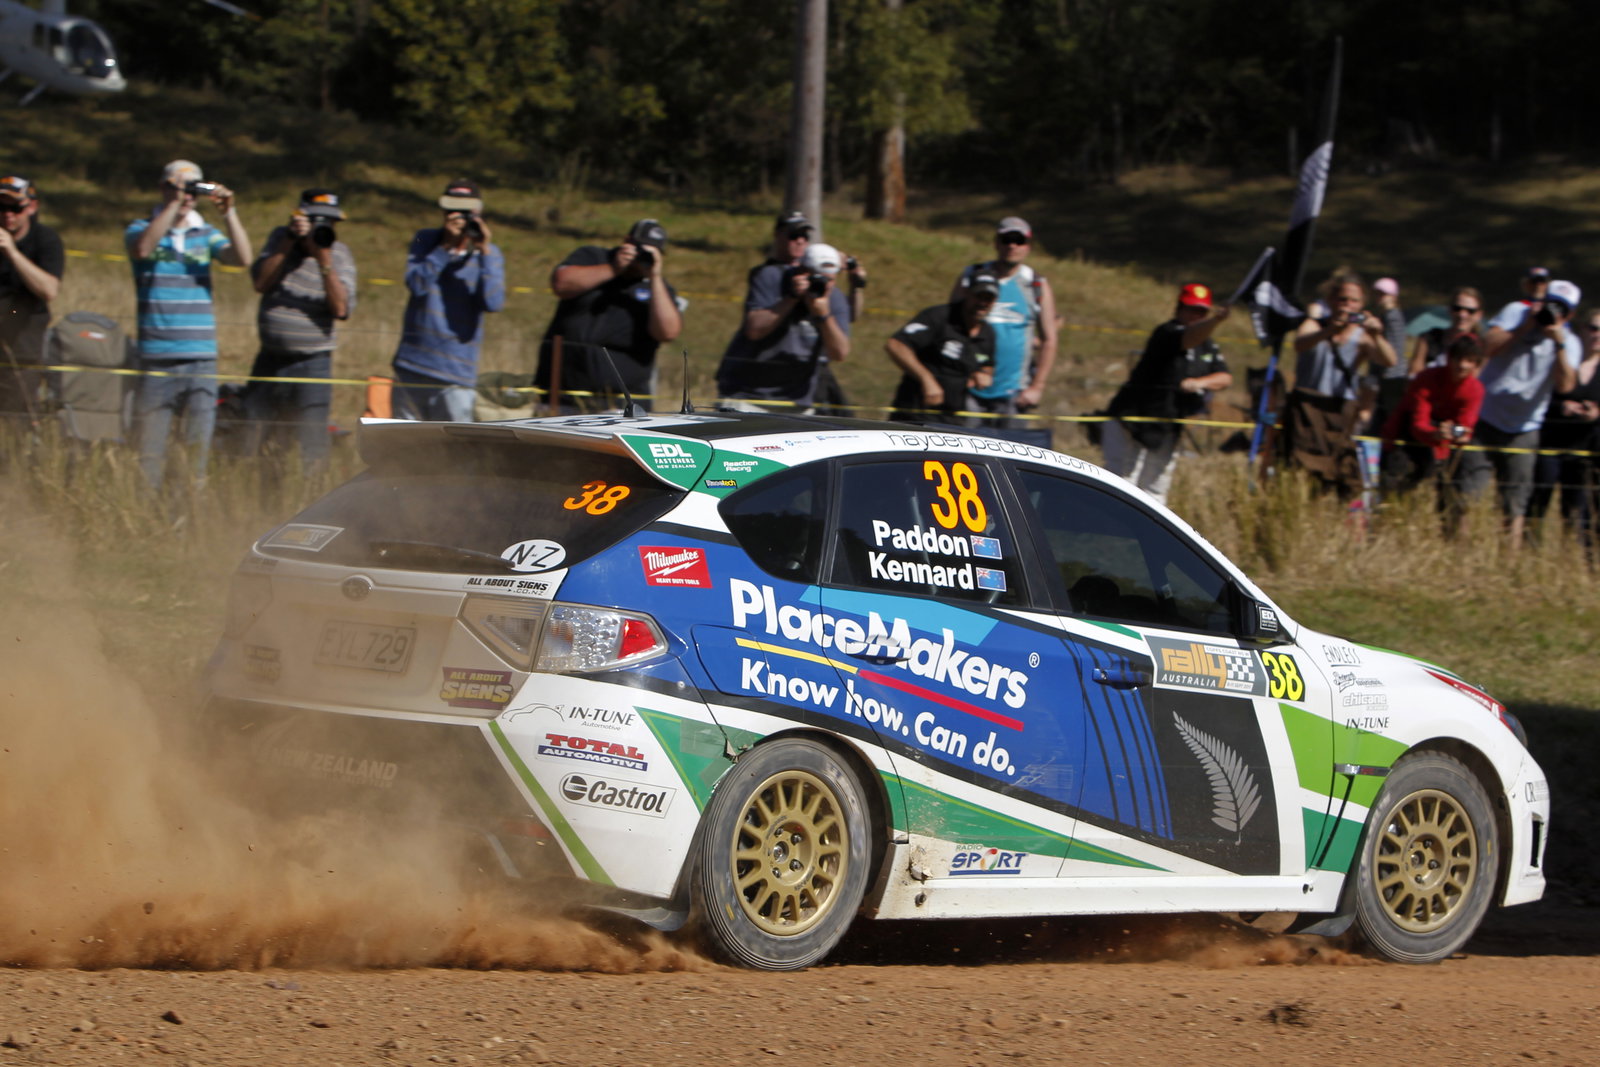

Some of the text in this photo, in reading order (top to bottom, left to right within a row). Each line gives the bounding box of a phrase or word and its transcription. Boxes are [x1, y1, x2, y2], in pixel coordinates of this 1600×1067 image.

[648, 443, 692, 458] EDL
[883, 431, 1100, 475] haydenpaddon.com
[723, 460, 759, 468] Reaction
[563, 480, 631, 516] 38
[923, 460, 988, 533] 38
[872, 519, 970, 557] Paddon
[644, 549, 700, 570] Milwaukee
[868, 551, 975, 590] Kennard
[467, 577, 549, 591] ALL ABOUT SIGNS
[655, 577, 671, 585] HEAVY
[685, 578, 700, 586] TOOLS
[1261, 610, 1277, 621] EDL
[729, 577, 1028, 709] PlaceMakers
[1321, 644, 1361, 664] ENDLESS
[450, 671, 504, 682] ALL ABOUT
[1161, 643, 1227, 689] rally
[1261, 651, 1304, 701] 38
[1161, 673, 1217, 688] AUSTRALIA
[440, 682, 514, 703] SIGNS
[568, 706, 636, 727] IN-TUNE
[581, 720, 621, 731] Automotive
[741, 657, 1015, 776] Know how. Can do.
[1345, 717, 1390, 730] IN-TUNE
[545, 733, 645, 761] TOTAL
[311, 752, 398, 780] ZEALAND
[543, 748, 644, 770] AUTOMOTIVE
[587, 780, 667, 813] Castrol
[951, 848, 1027, 871] SPORT
